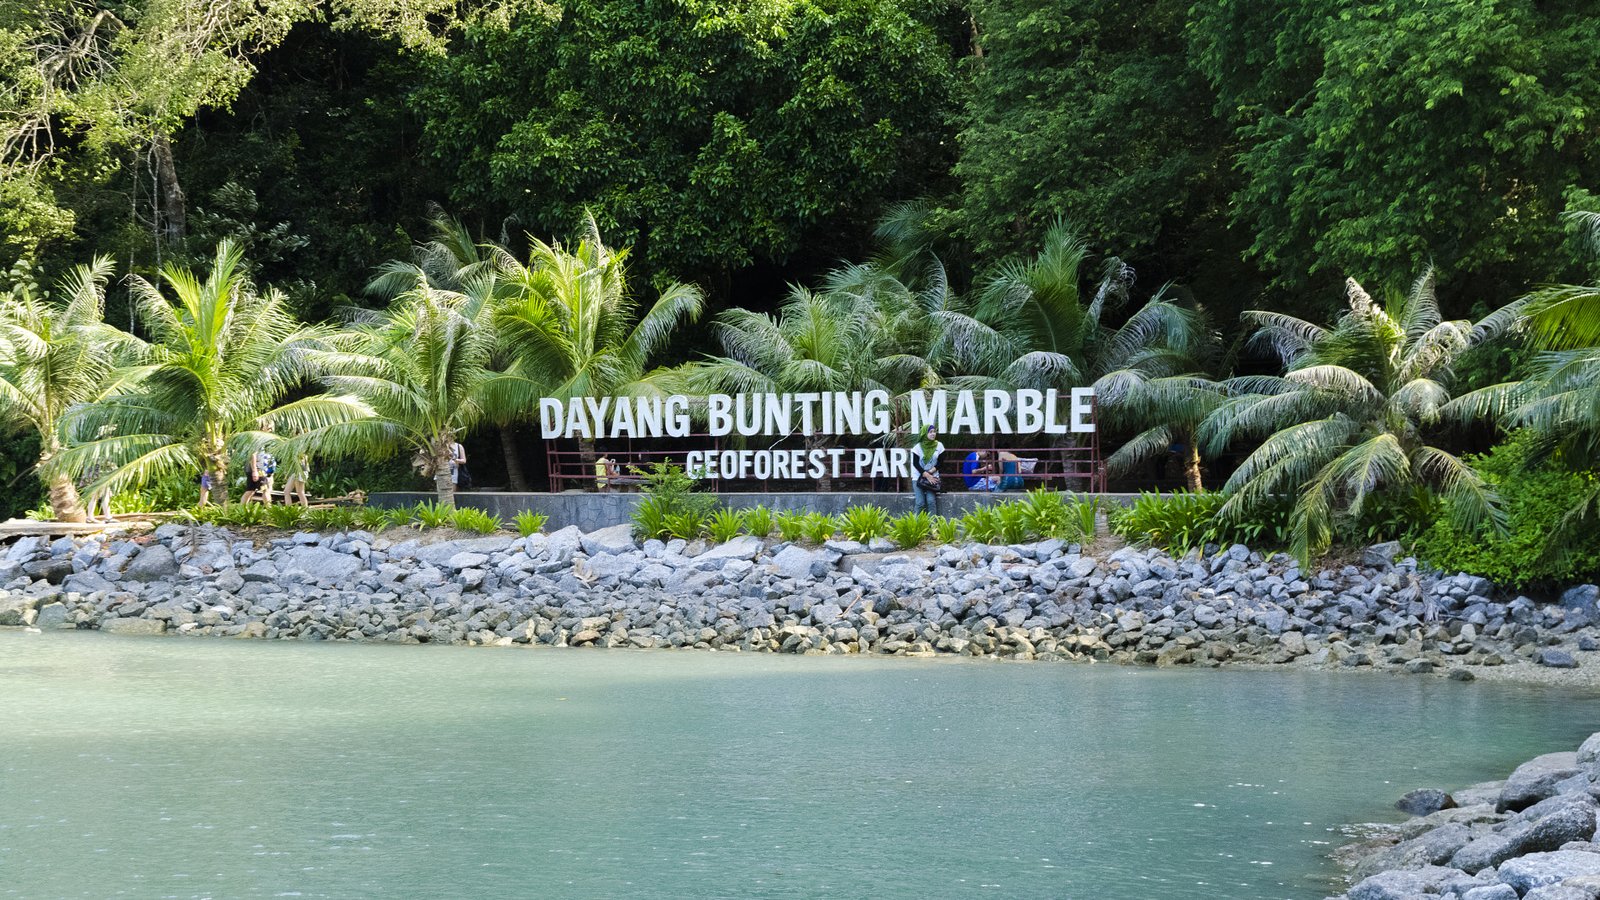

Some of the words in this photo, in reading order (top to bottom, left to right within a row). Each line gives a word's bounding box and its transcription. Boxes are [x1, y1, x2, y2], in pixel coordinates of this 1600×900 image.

[539, 395, 690, 439] DAYANG
[708, 390, 890, 437] BUNTING
[910, 387, 1096, 435] MARBLE
[686, 448, 846, 480] GEOFOREST
[854, 448, 915, 479] PAR
